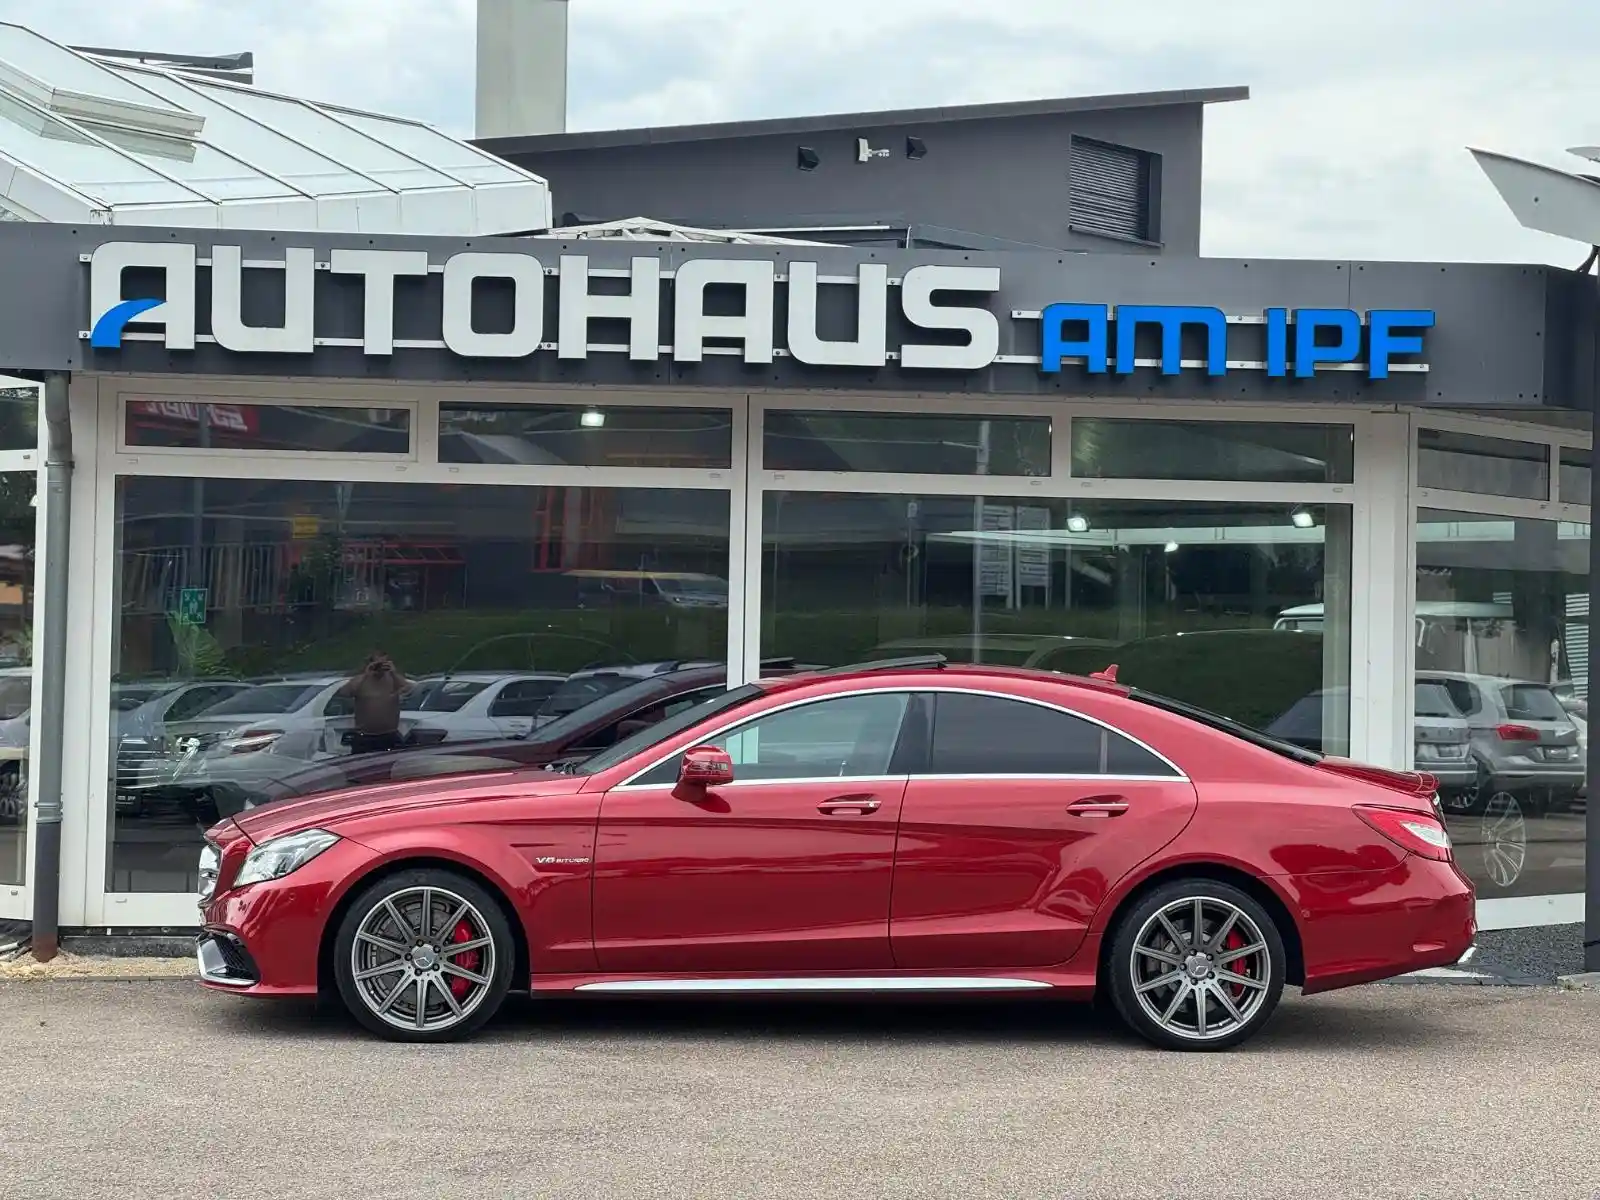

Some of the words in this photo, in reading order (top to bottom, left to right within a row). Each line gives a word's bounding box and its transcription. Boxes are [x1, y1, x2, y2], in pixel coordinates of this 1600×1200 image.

[89, 241, 1001, 370] AUTOHAUS
[1041, 302, 1227, 377] AM
[1267, 307, 1436, 380] IPF
